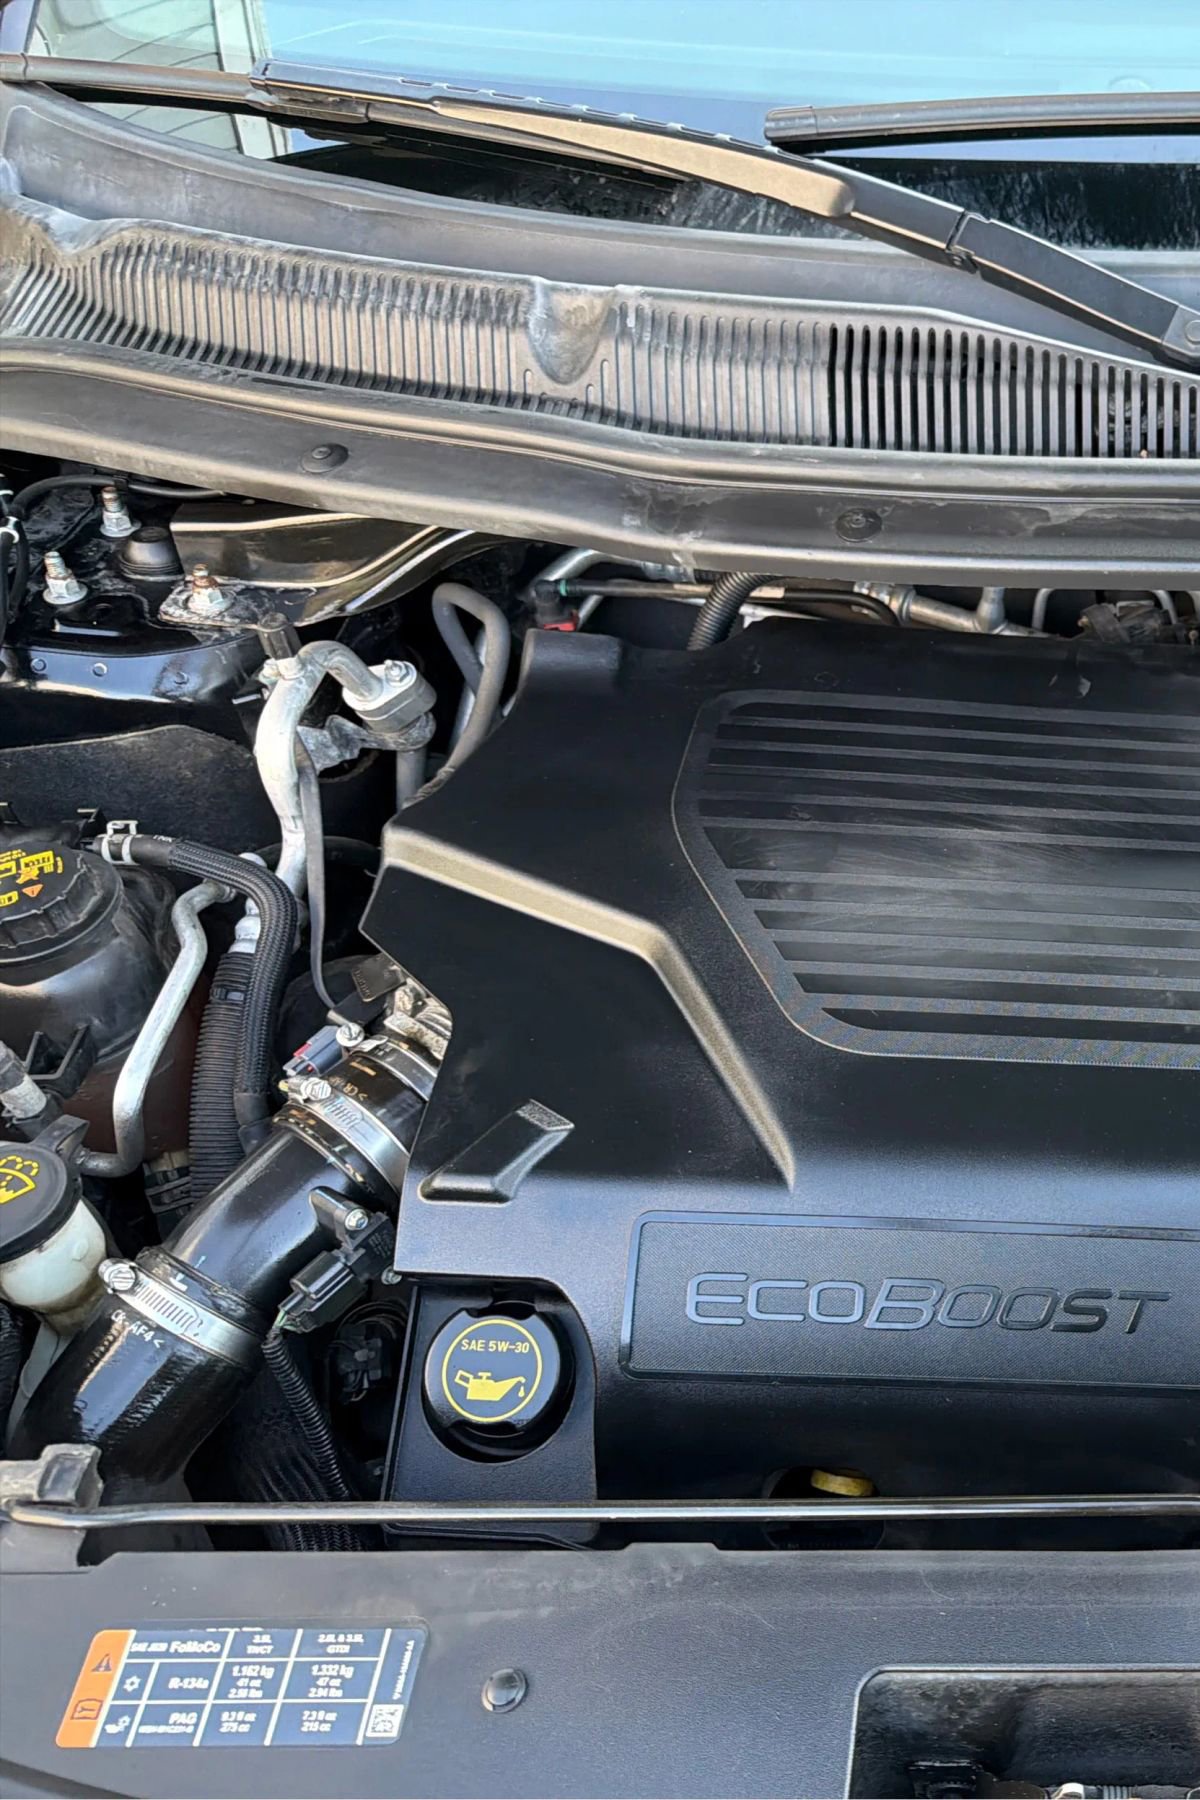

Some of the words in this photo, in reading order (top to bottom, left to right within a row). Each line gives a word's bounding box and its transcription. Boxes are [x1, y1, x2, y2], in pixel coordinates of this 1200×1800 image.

[461, 1339, 486, 1351] SAE
[488, 1340, 530, 1353] 5W-30
[169, 1640, 221, 1653] FoMoCo
[168, 1712, 198, 1725] PAG
